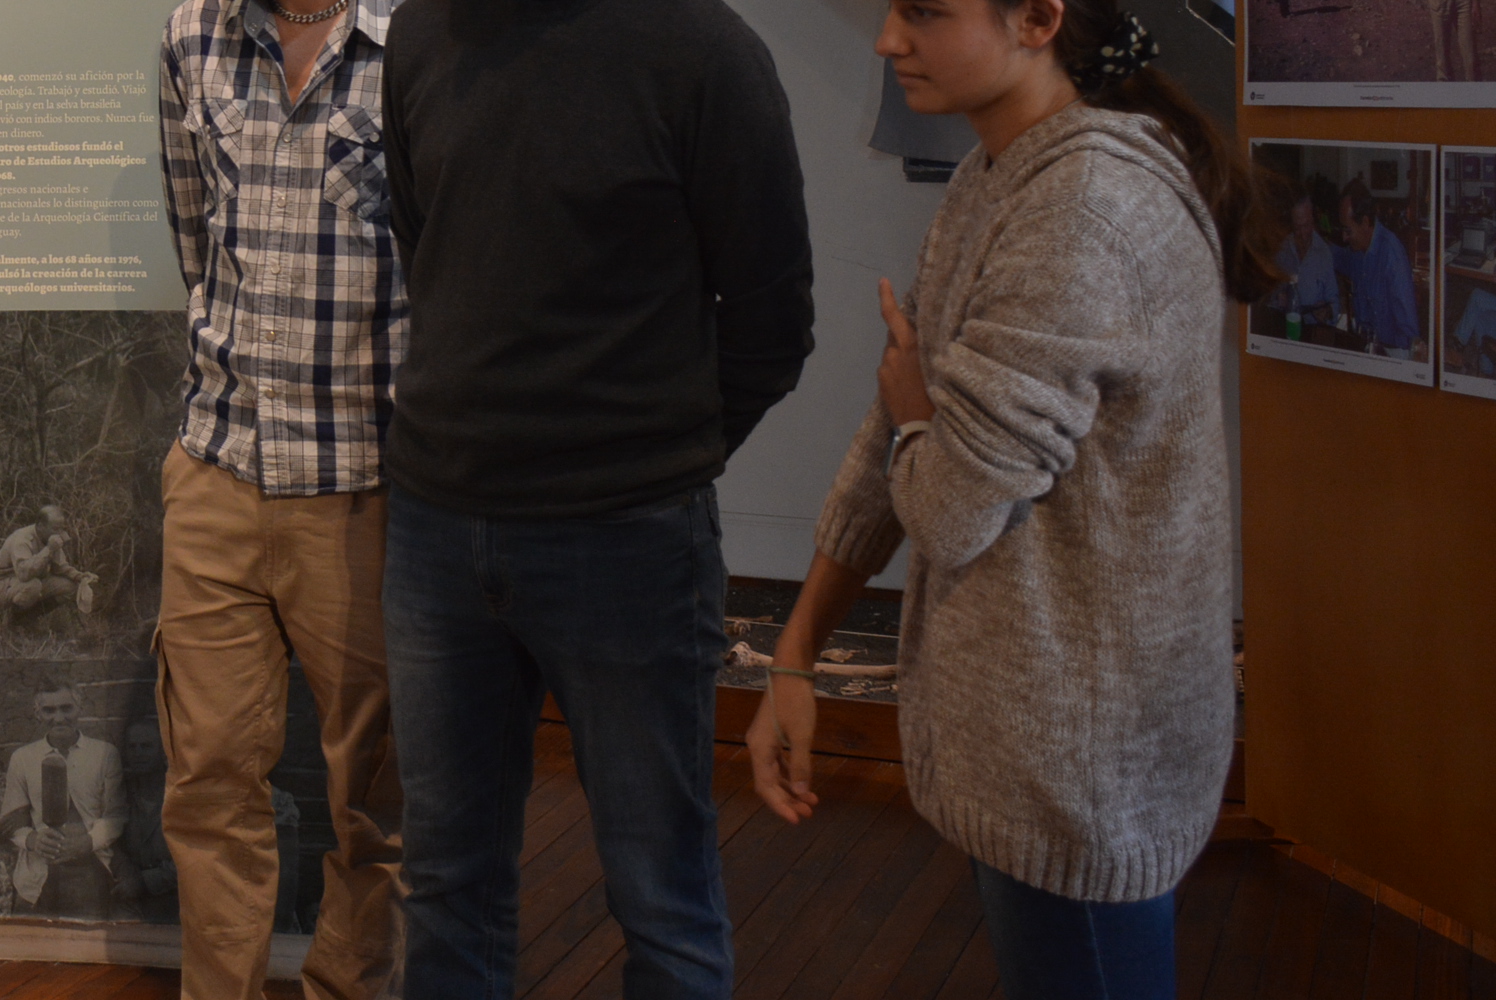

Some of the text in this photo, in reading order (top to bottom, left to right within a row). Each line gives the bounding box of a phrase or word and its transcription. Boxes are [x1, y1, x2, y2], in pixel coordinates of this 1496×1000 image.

[18, 71, 63, 82] comenzó
[65, 73, 77, 81] su
[79, 70, 114, 81] afición
[116, 72, 134, 83] por
[135, 69, 145, 80] la
[13, 155, 26, 166] de
[27, 155, 72, 166] Estudios
[73, 154, 147, 168] Arqueológicos
